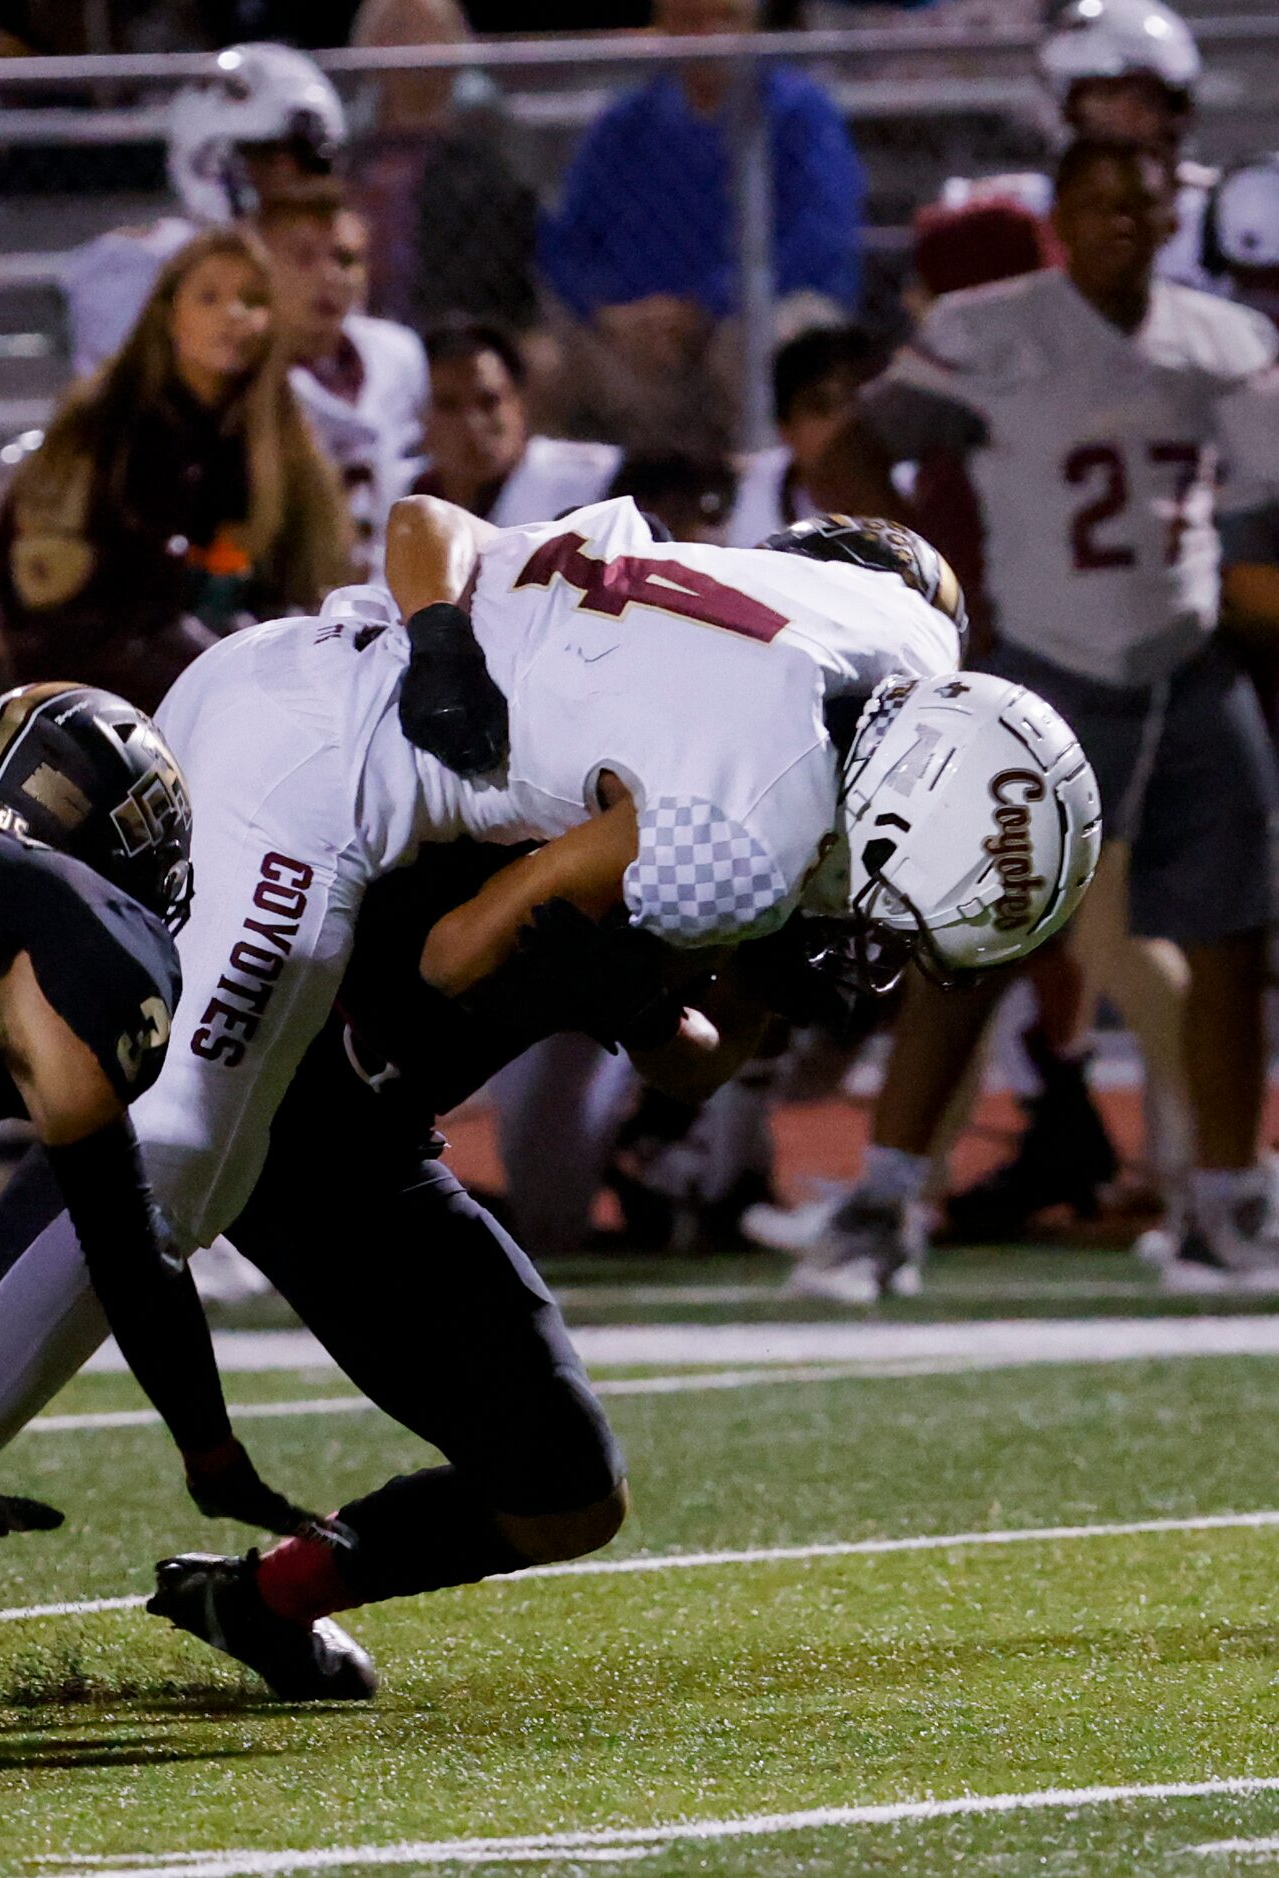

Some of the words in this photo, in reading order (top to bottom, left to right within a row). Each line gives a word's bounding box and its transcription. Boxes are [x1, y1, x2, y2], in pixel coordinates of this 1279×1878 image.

[1065, 445, 1210, 568] 27
[981, 768, 1046, 932] Coyotes
[191, 852, 313, 1067] COYOTES
